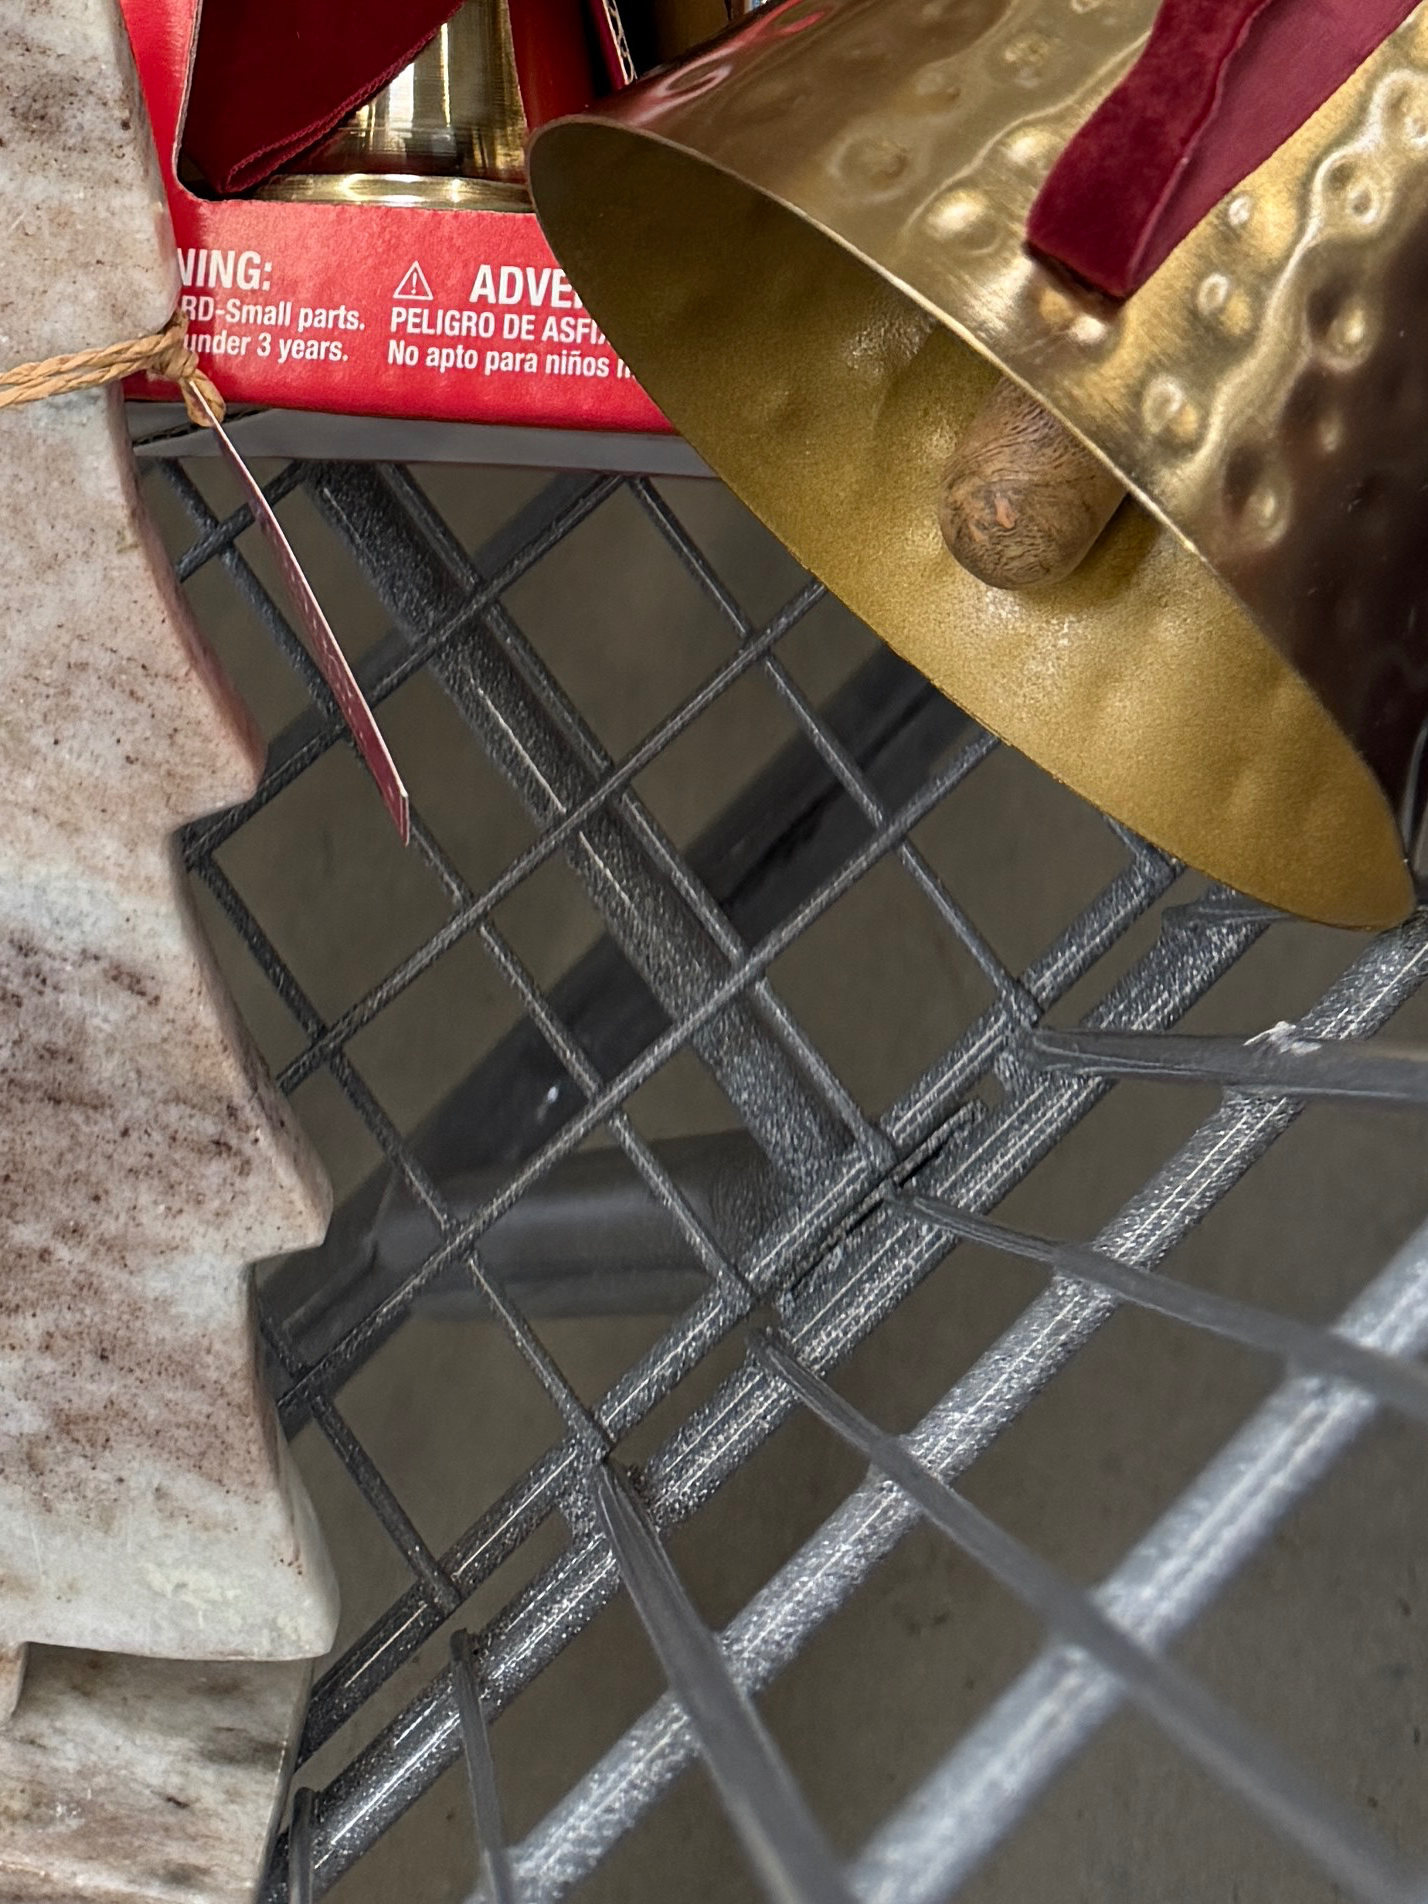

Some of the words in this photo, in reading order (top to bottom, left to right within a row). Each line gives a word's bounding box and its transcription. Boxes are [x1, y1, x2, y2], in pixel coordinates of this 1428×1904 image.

[297, 304, 366, 333] parts.
[390, 306, 496, 338] PELIGRO
[502, 313, 536, 341] DE
[184, 329, 252, 356] under
[256, 333, 272, 357] 3
[277, 337, 349, 364] years.
[387, 340, 420, 366] No
[426, 344, 479, 373] apto
[485, 350, 538, 376] para
[544, 350, 610, 378] niños
